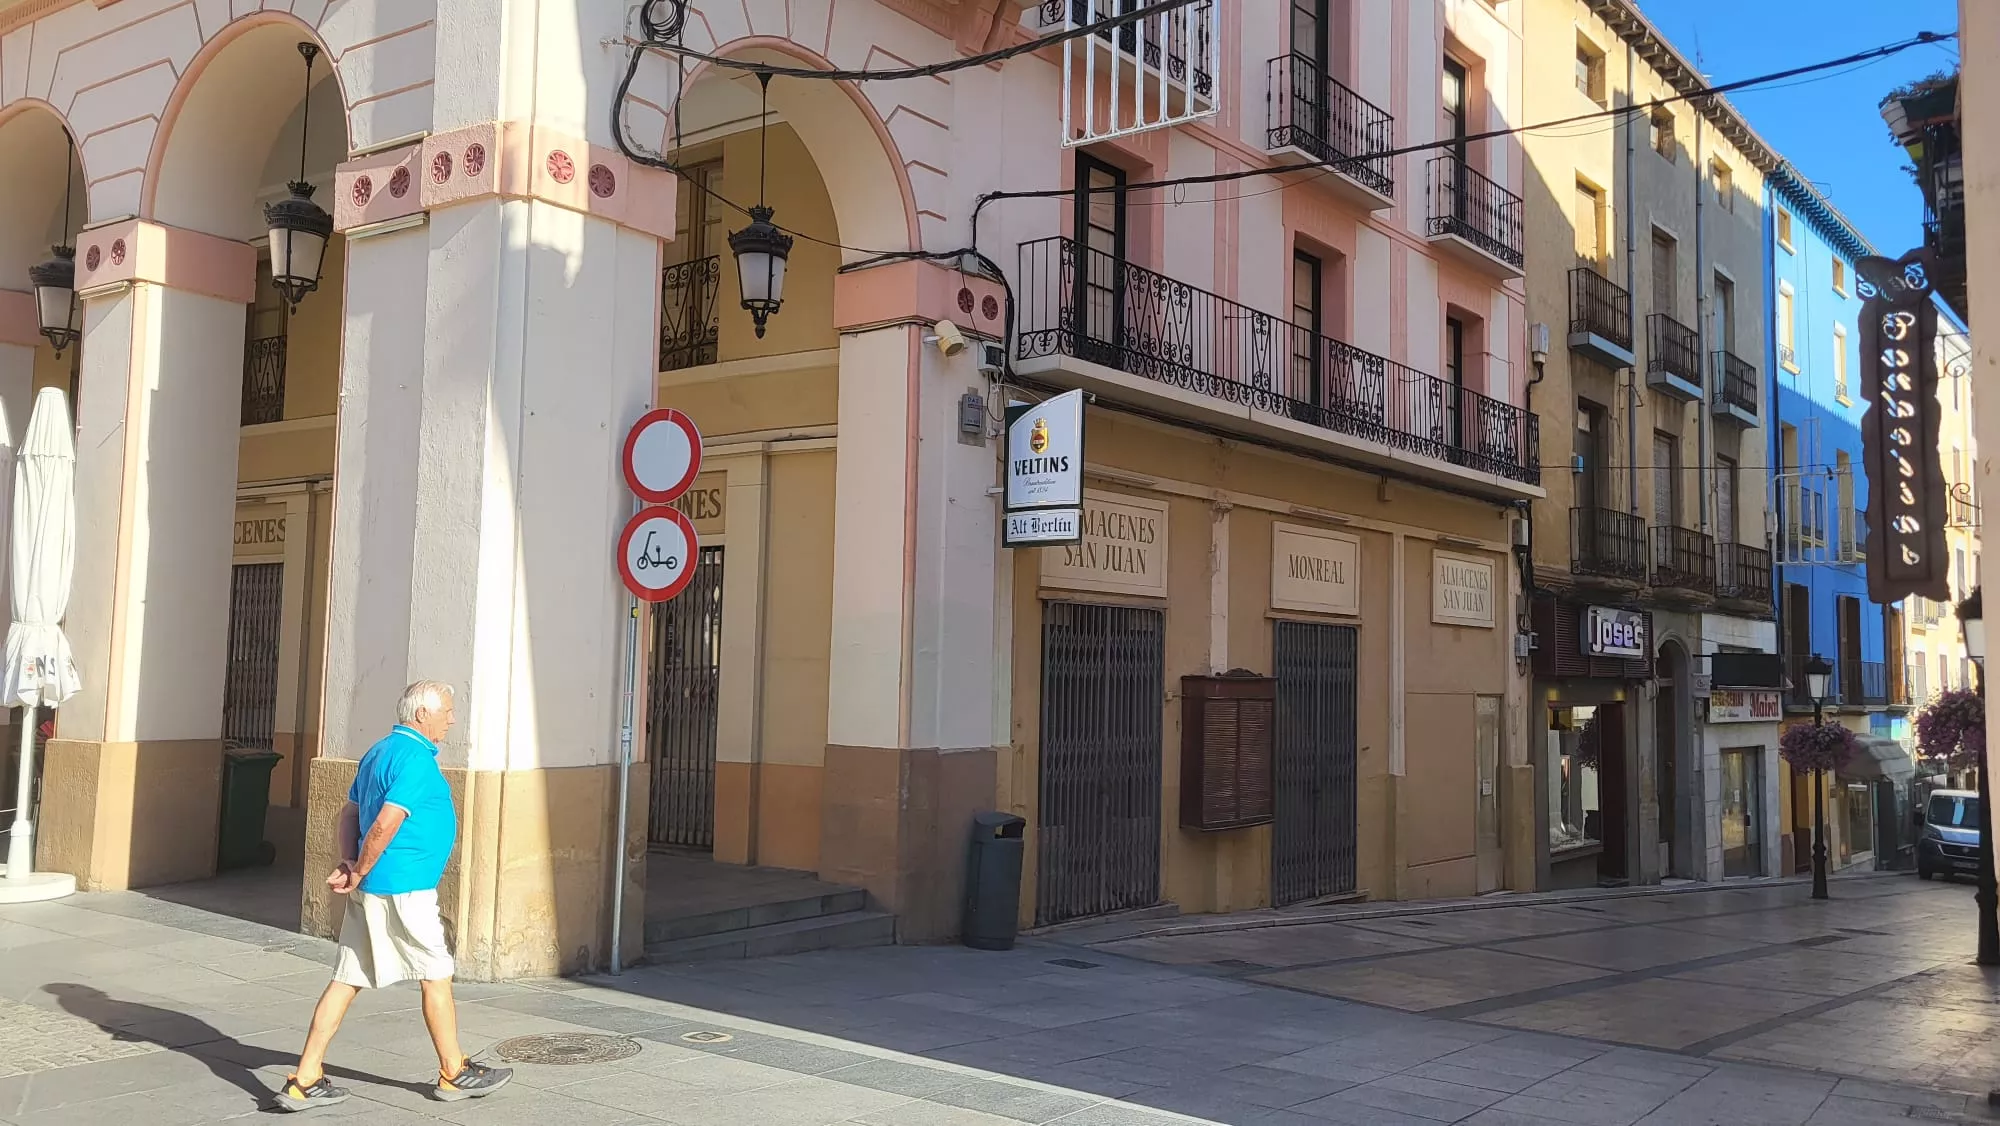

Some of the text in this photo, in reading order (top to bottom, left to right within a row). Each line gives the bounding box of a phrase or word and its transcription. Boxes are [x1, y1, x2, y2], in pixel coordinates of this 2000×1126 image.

[1014, 455, 1069, 476] VELTINS
[1010, 516, 1071, 536] Alt Berlin
[1063, 541, 1147, 575] SAN JUAN
[1288, 553, 1345, 585] MONREAL
[1439, 563, 1488, 591] ALMACENES
[1443, 588, 1484, 613] SAN JUAN
